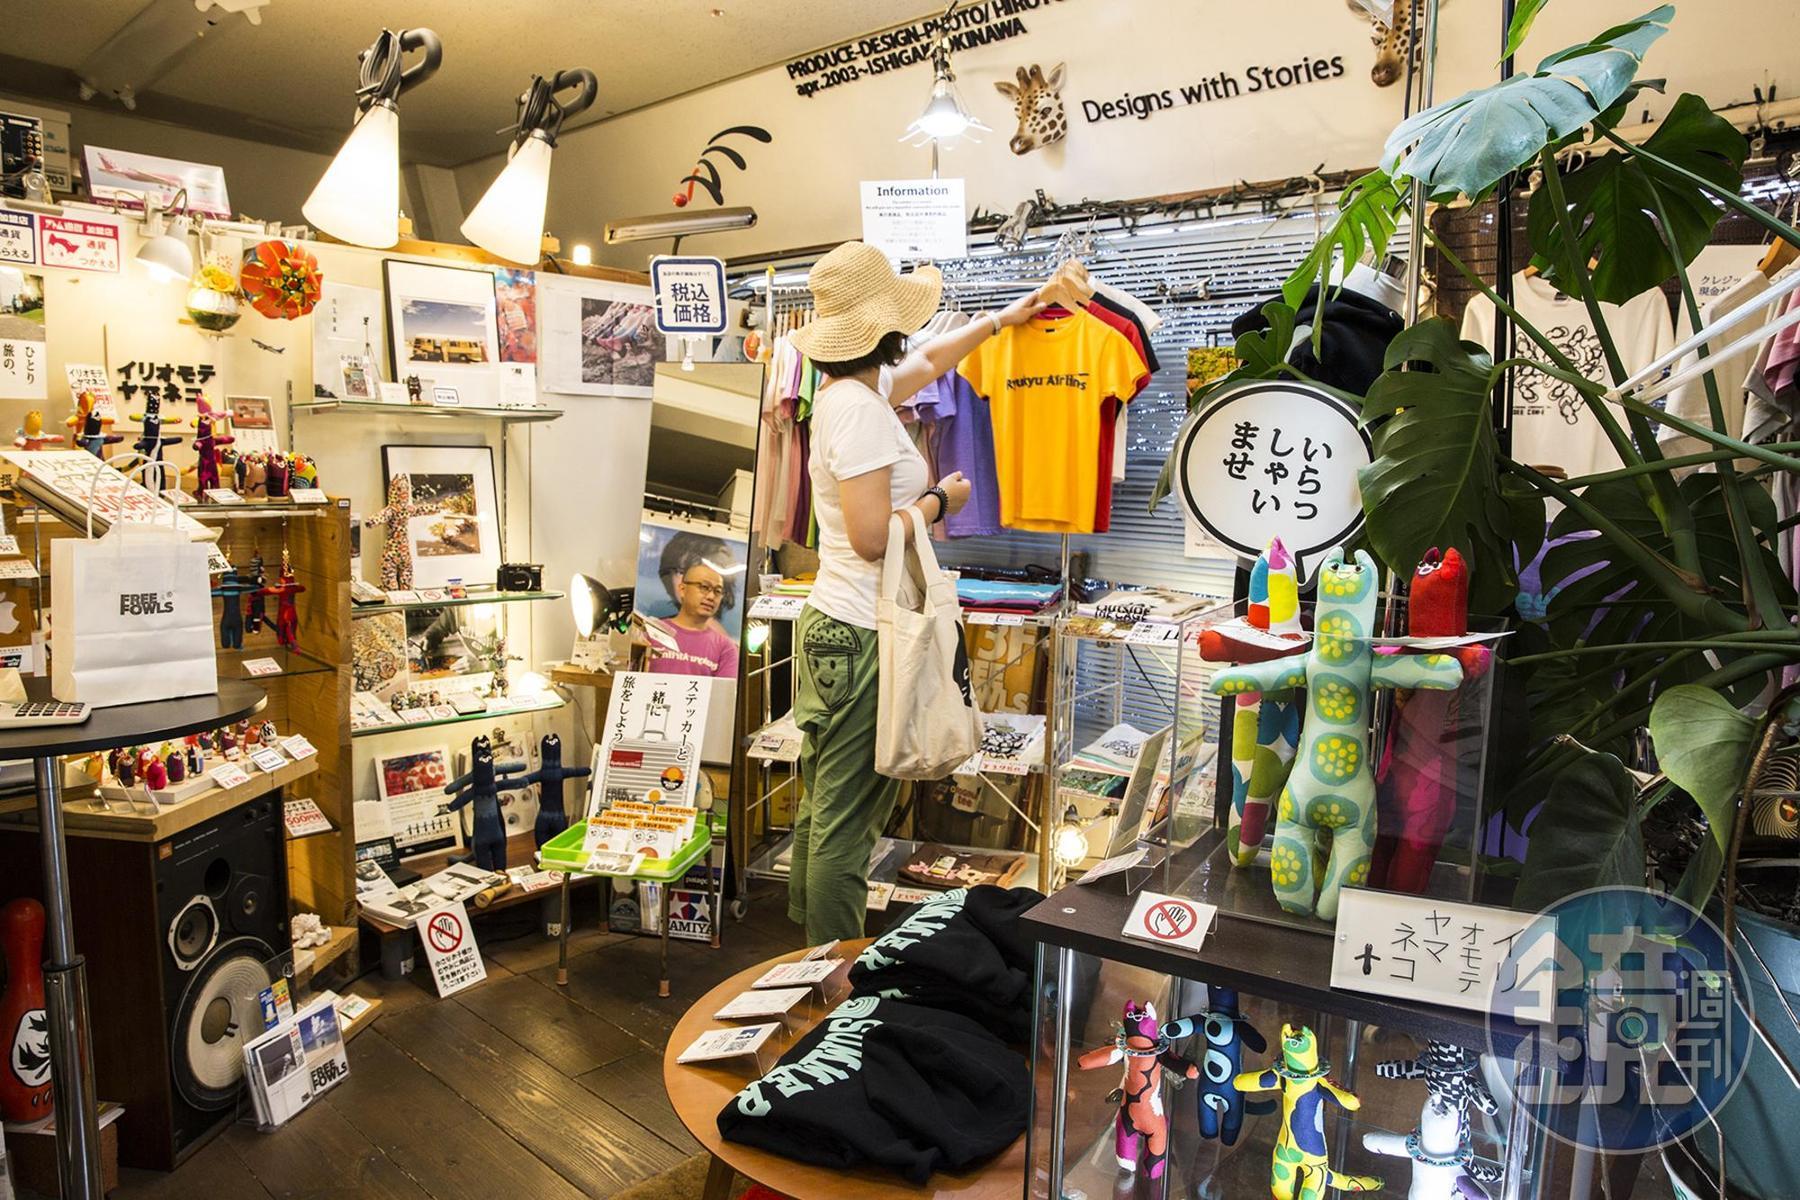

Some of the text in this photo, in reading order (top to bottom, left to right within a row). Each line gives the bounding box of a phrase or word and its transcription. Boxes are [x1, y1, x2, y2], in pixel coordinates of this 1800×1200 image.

[1082, 55, 1344, 123] Designs with Stories
[877, 186, 949, 196] Information
[0, 247, 30, 259] らえる
[671, 282, 709, 302] 税込
[25, 346, 35, 385] ひとり
[117, 361, 216, 382] イリオモテ
[120, 593, 158, 606] FREE
[120, 602, 174, 615] FOWLS
[614, 675, 637, 741] 旅をしよう
[650, 682, 668, 717] 一緒に
[677, 680, 699, 761] ステッカーと
[310, 1058, 337, 1080] FREE
[312, 1061, 348, 1091] FOWLS
